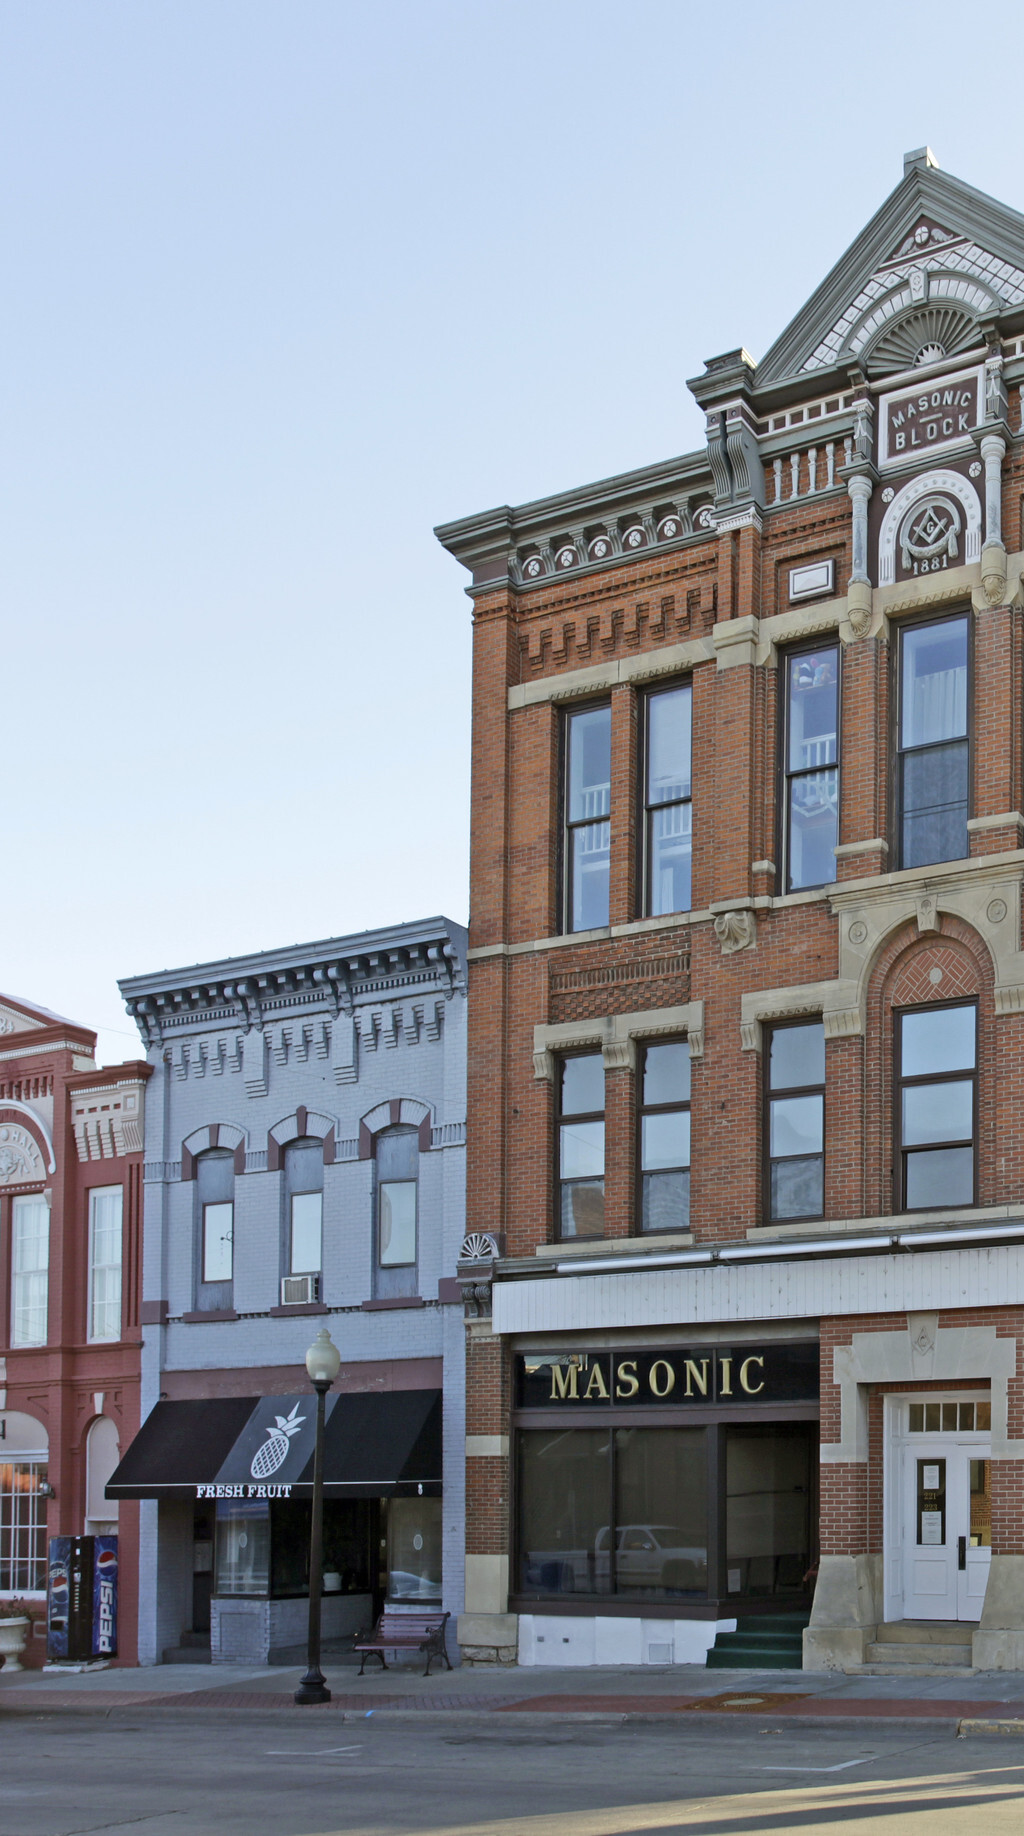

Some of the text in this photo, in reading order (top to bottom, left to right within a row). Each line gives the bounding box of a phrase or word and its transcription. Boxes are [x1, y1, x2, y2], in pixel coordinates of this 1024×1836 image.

[891, 390, 971, 428] MASONIC
[895, 412, 968, 450] BLOCK
[926, 521, 935, 533] G
[913, 554, 948, 575] 1881
[11, 1130, 39, 1168] HALL
[549, 1356, 765, 1399] MASONIC
[196, 1485, 292, 1498] FRESH FRUIT
[98, 1580, 113, 1653] PEPSI
